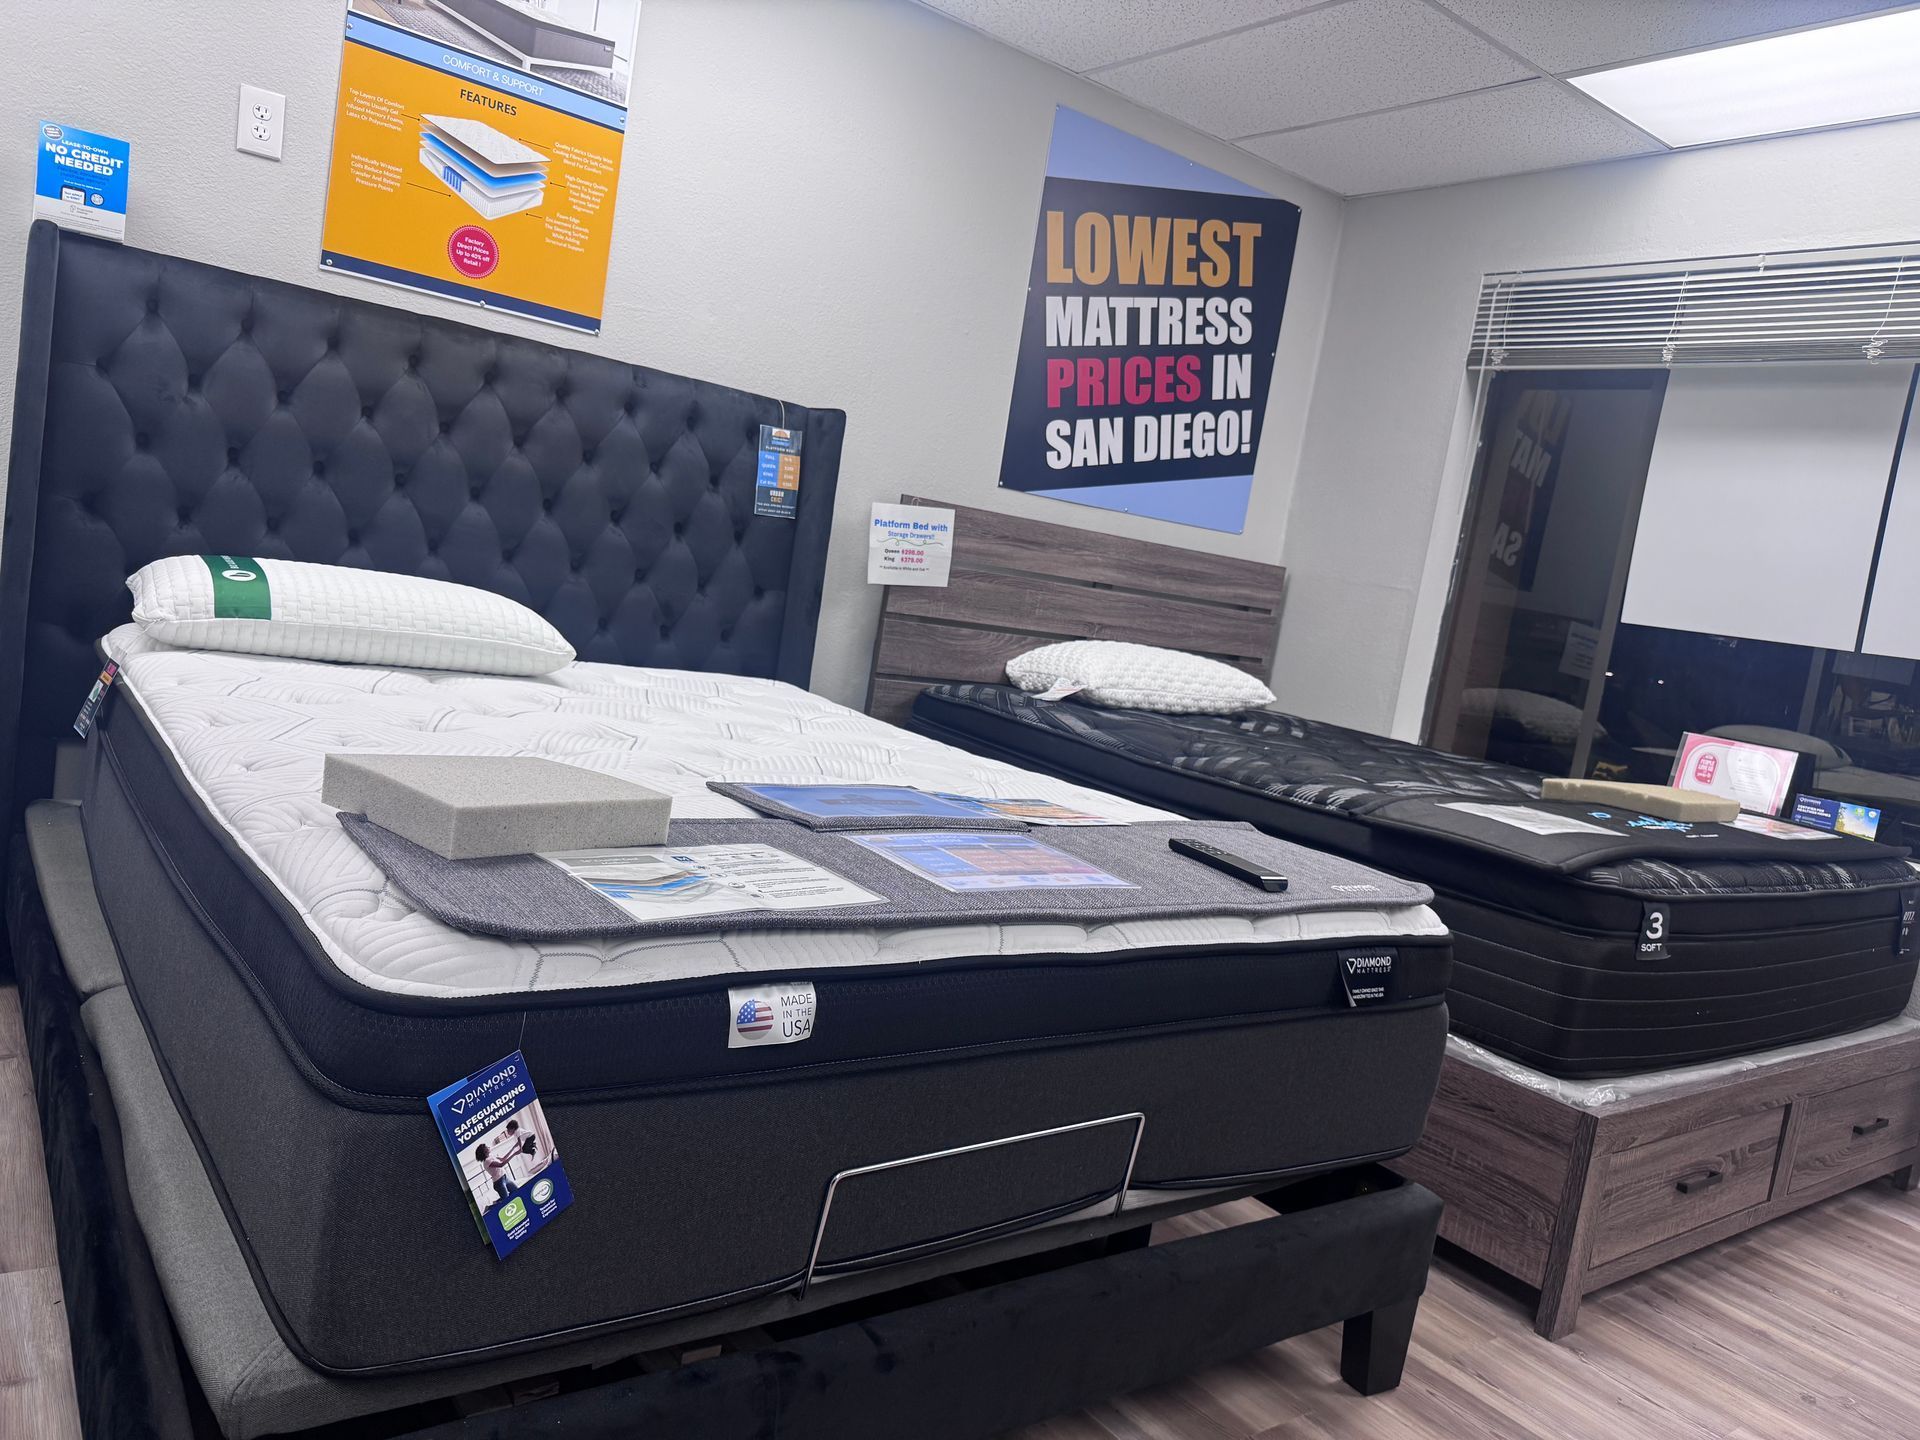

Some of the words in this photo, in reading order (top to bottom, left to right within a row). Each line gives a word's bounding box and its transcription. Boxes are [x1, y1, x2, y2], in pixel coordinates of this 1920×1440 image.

[443, 55, 491, 78] COMFORT
[492, 72, 500, 81] &
[501, 75, 544, 96] SUPPORT
[360, 90, 376, 100] Layers
[460, 89, 517, 116] FEATURES
[371, 102, 389, 113] Usually
[45, 142, 67, 155] NO
[71, 149, 123, 169] CREDIT
[61, 140, 109, 155] LEASE-TO-OWN
[54, 155, 113, 176] NEEDED
[457, 242, 472, 250] Direct
[473, 246, 489, 255] Prices
[465, 237, 485, 247] Factory
[1046, 210, 1262, 288] LOWEST
[464, 258, 478, 266] Retail
[1046, 296, 1253, 347] MATTRESS
[1047, 355, 1201, 408] PRICES
[1211, 353, 1252, 401] IN
[1045, 415, 1124, 470] SAN
[1133, 409, 1252, 462] DIEGO!
[874, 519, 910, 529] Platform
[913, 522, 929, 530] Bed
[931, 524, 948, 532] with
[888, 531, 908, 539] Storage
[1646, 912, 1663, 939] 3
[1641, 943, 1662, 952] SOFT
[1356, 956, 1392, 968] DIAMOND
[1356, 966, 1391, 974] MATTRESS
[781, 994, 812, 1007] MADE
[783, 1010, 792, 1018] IN
[796, 1008, 811, 1016] THE
[783, 1019, 810, 1037] USA
[465, 1065, 516, 1103] DIAMOND
[469, 1073, 517, 1108] MATTRESS
[454, 1083, 526, 1137] SAFEGUARDING
[458, 1123, 484, 1145] YOUR
[484, 1100, 516, 1127] FAMILY
